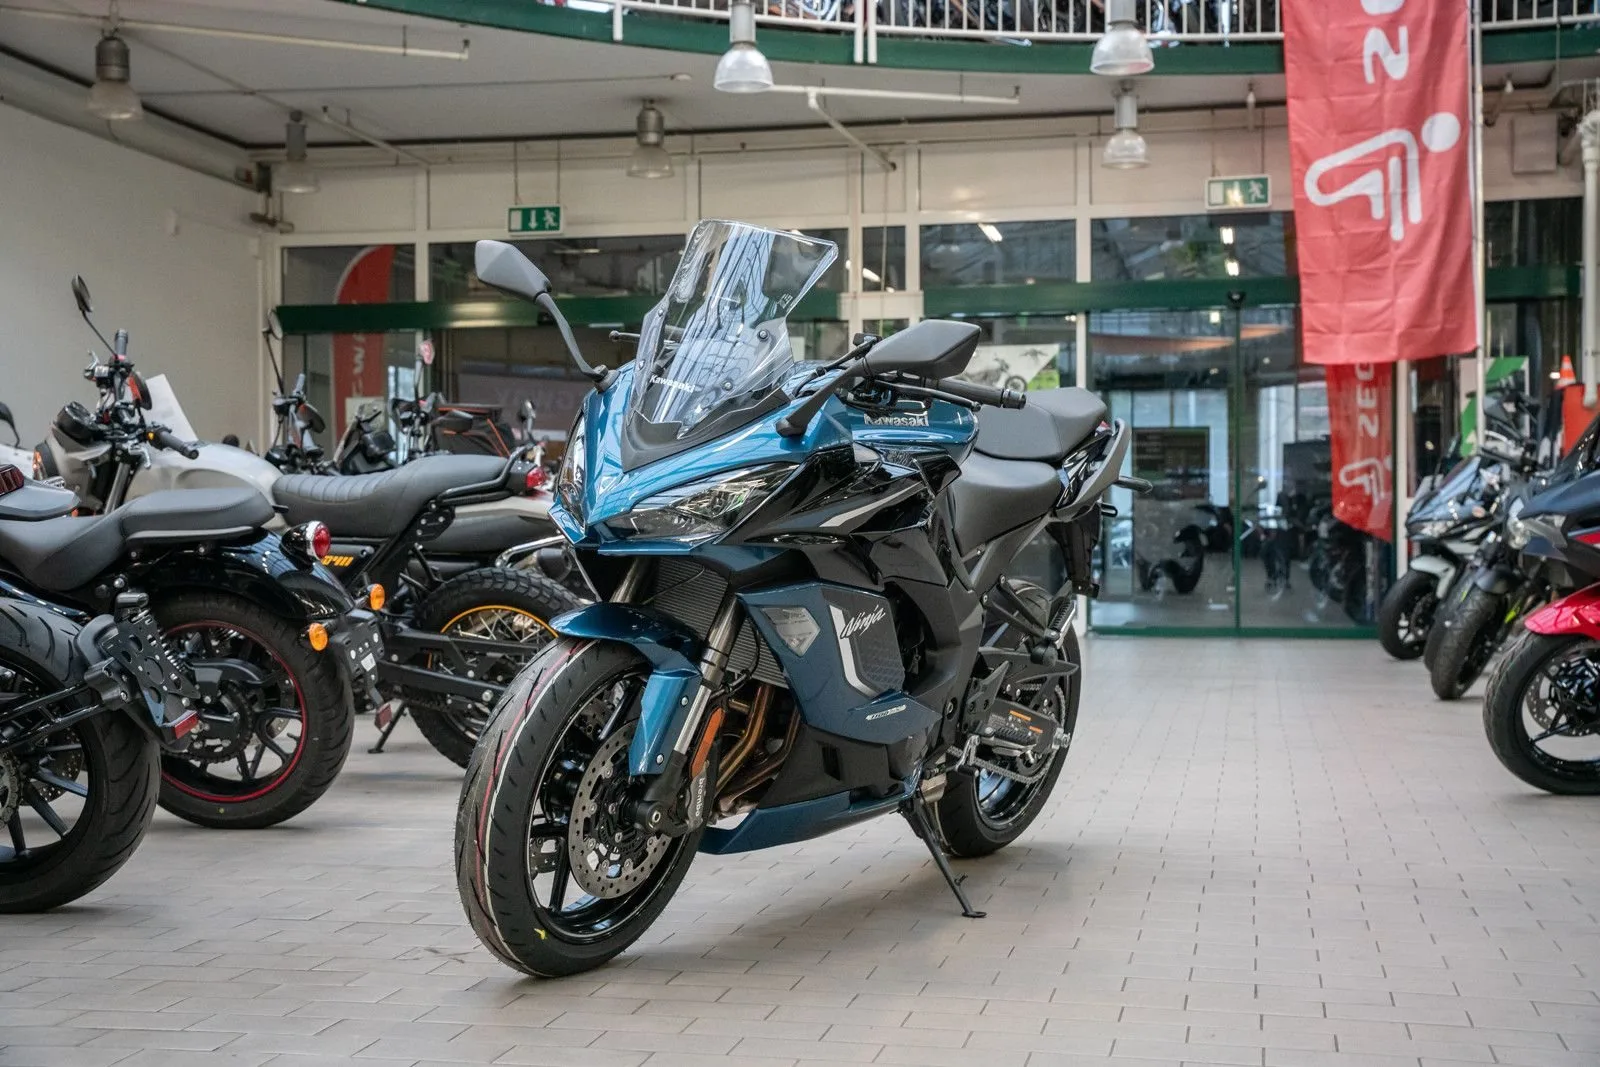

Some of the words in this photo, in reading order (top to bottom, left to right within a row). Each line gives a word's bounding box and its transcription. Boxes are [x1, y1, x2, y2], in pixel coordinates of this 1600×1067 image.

[863, 412, 930, 427] Kawasaki
[840, 604, 886, 640] Ninja
[695, 777, 706, 817] brembo
